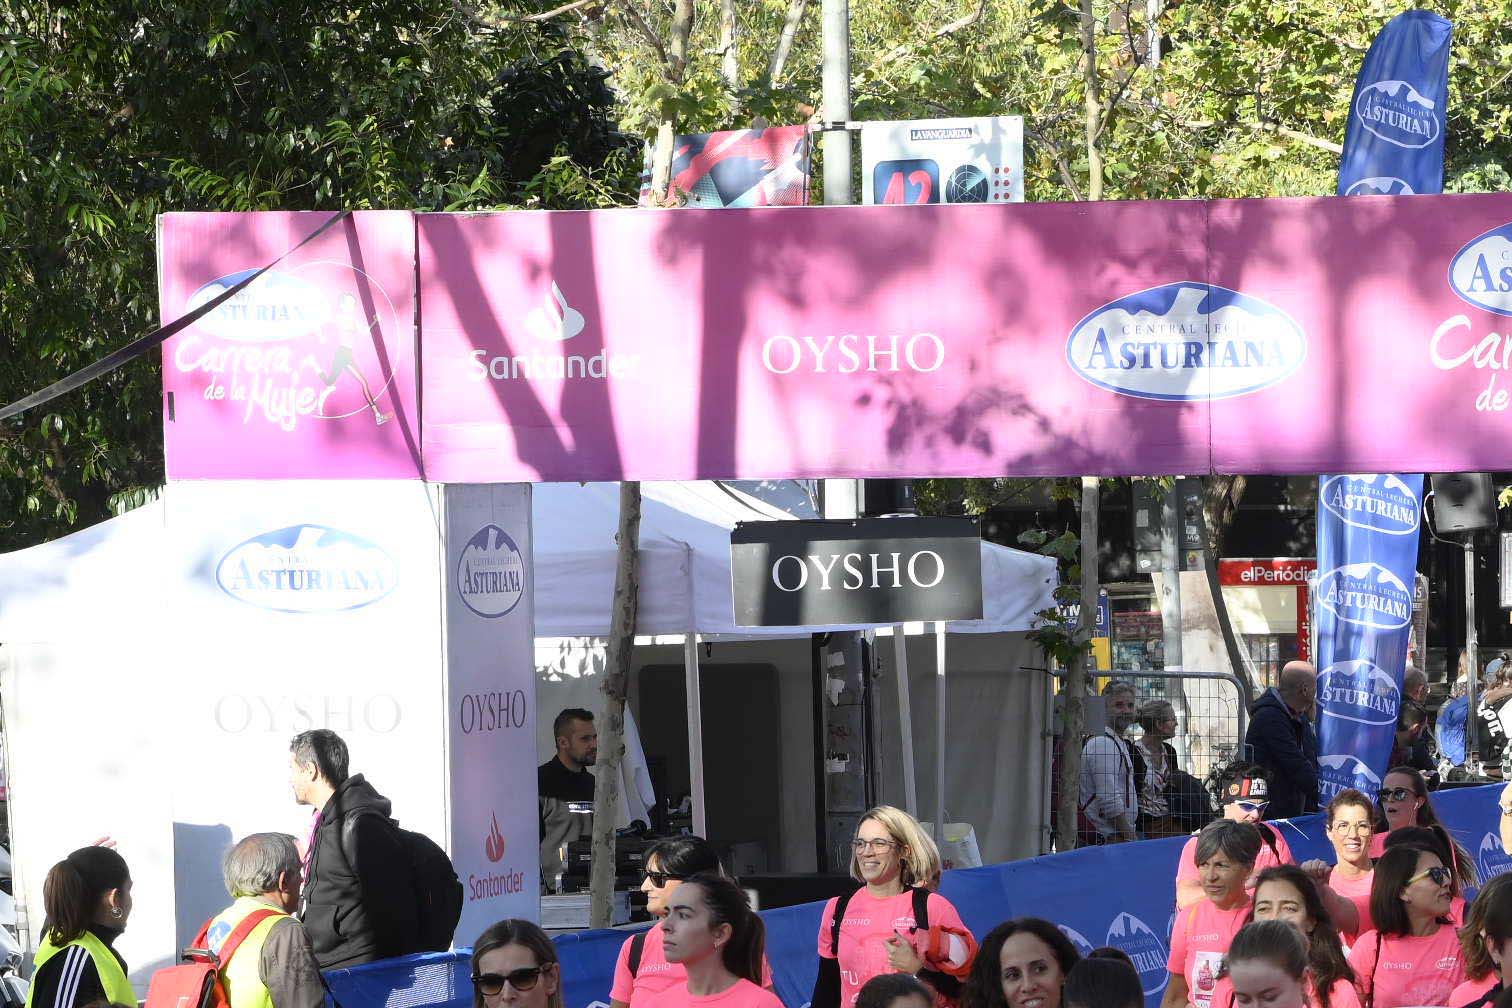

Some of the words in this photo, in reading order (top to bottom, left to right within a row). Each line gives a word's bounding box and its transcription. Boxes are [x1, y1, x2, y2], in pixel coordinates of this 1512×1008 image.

[467, 347, 641, 382] Santander
[762, 331, 945, 374] OYSHO
[1087, 327, 1287, 370] ASTURIANA
[1475, 373, 1508, 413] de
[1331, 483, 1416, 526] ASTURIANA
[230, 557, 387, 592] ASTURIANA
[463, 558, 521, 596] ASTURIANA
[771, 549, 945, 593] OYSHO
[213, 693, 404, 737] OYSHO
[461, 688, 527, 735] OYSHO
[469, 869, 526, 903] Santander
